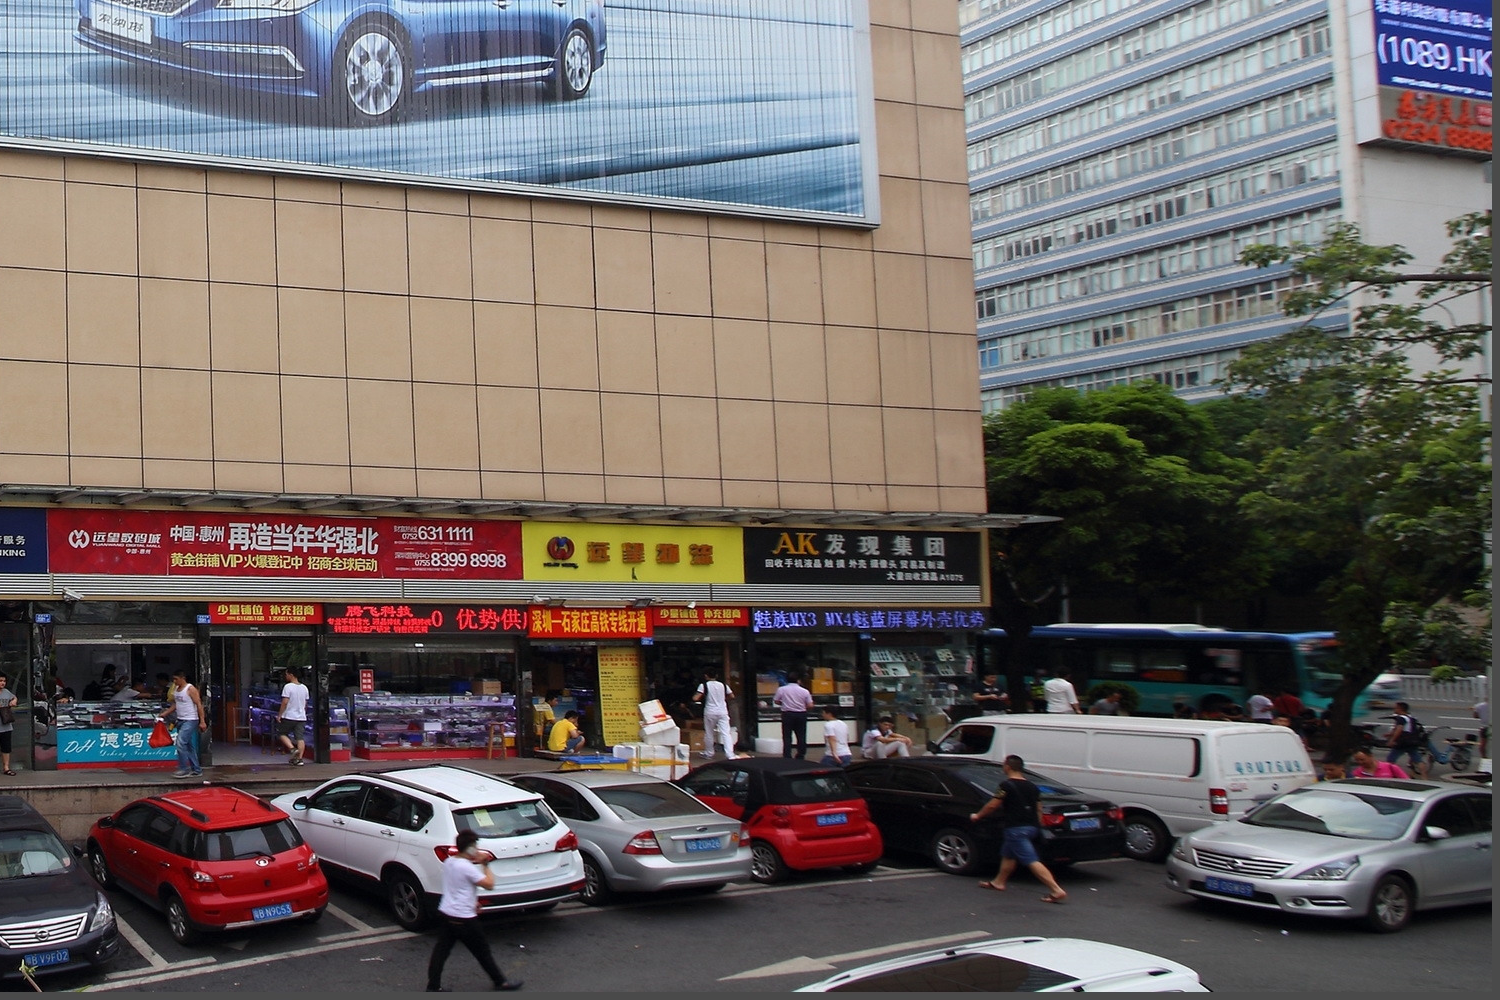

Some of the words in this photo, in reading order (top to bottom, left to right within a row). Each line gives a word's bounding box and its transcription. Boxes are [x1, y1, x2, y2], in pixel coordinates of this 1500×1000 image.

[92, 532, 162, 544] 远望数码城
[772, 532, 820, 555] AK
[825, 534, 946, 557] 发现集团
[308, 556, 378, 572] 招商全球启动
[431, 552, 467, 567] 8399
[470, 553, 507, 568] 8998
[217, 604, 263, 615] 少量铺位
[269, 605, 315, 616] 补充招商
[345, 605, 414, 618] 腾飞科技
[456, 608, 527, 631] 优势供
[100, 731, 177, 749] 德鸿
